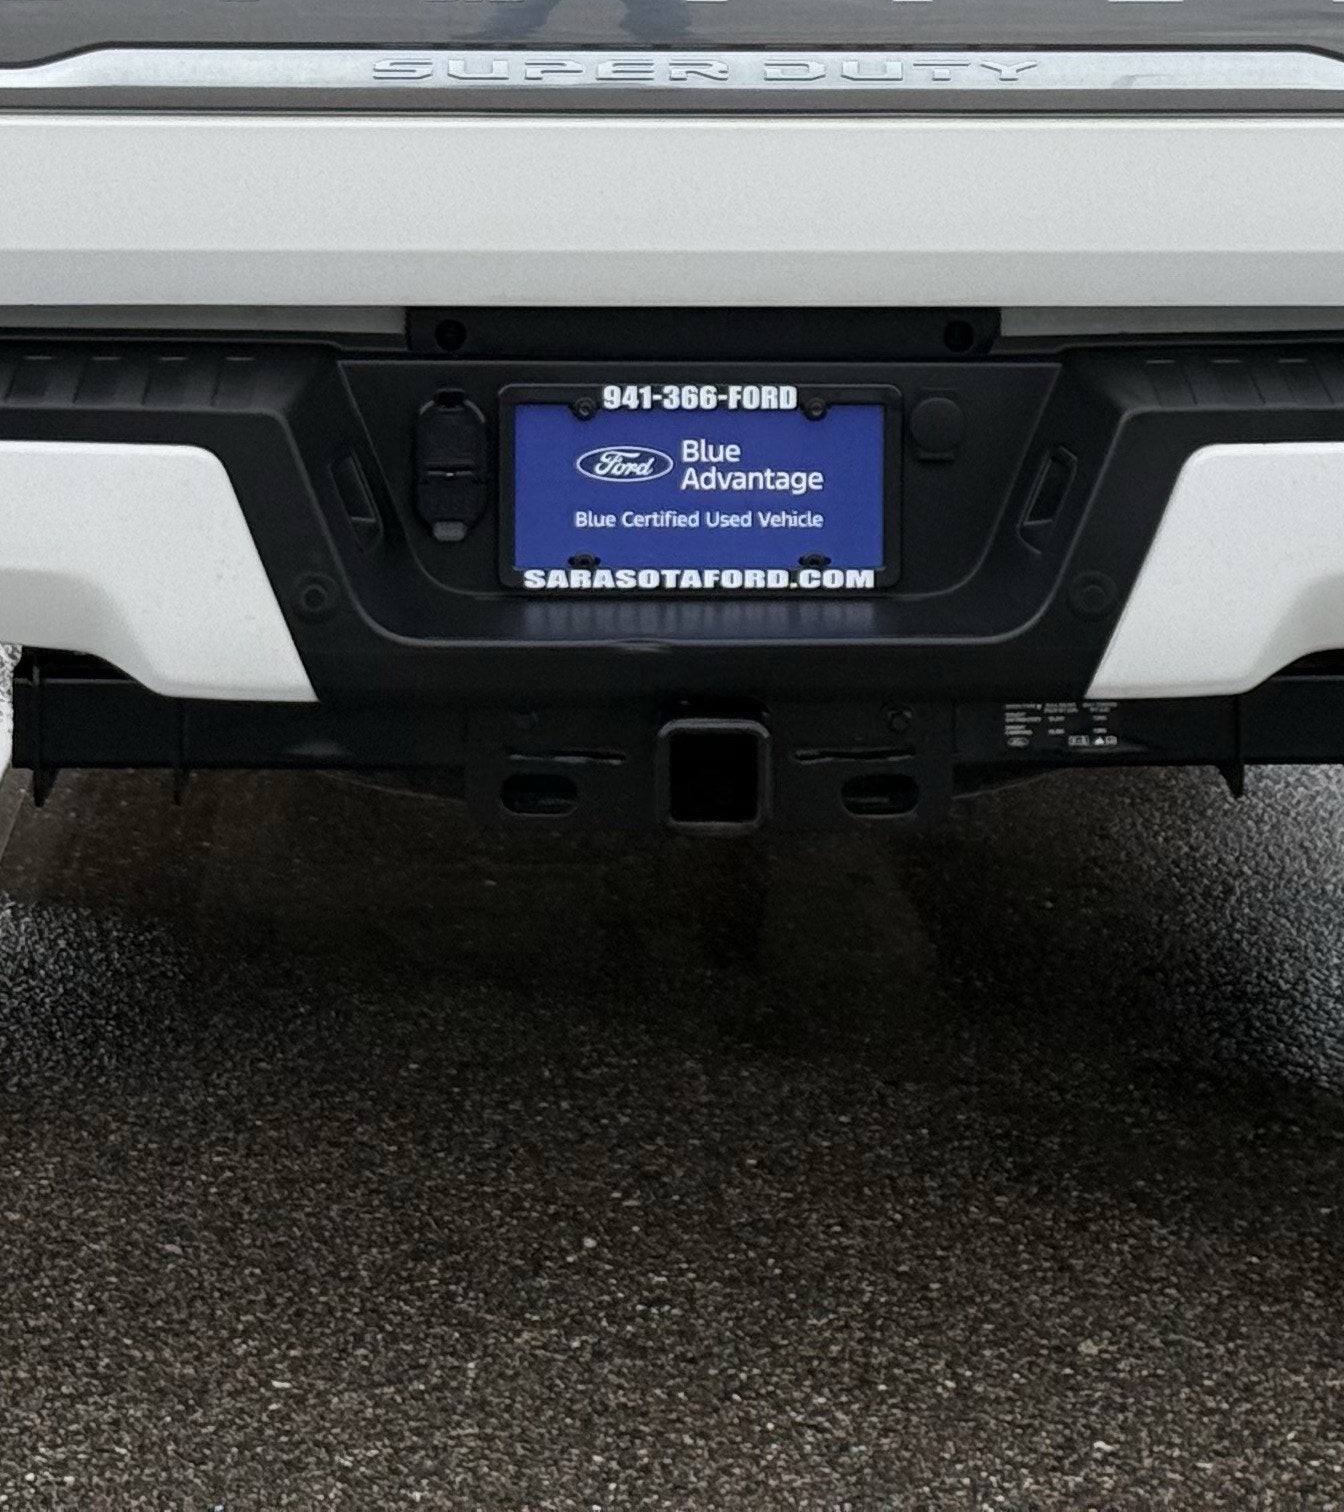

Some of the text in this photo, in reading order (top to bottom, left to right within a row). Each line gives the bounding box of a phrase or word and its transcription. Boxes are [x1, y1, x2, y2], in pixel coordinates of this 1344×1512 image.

[372, 56, 1039, 82] SUPER DUTY
[602, 384, 798, 411] 941-366-FORD
[592, 449, 656, 477] Ford
[681, 438, 741, 464] Blue
[679, 465, 824, 495] Advantage
[574, 509, 824, 529] Blue Certified Used Vehicle
[523, 568, 875, 590] SARASOTAFORD.COM
